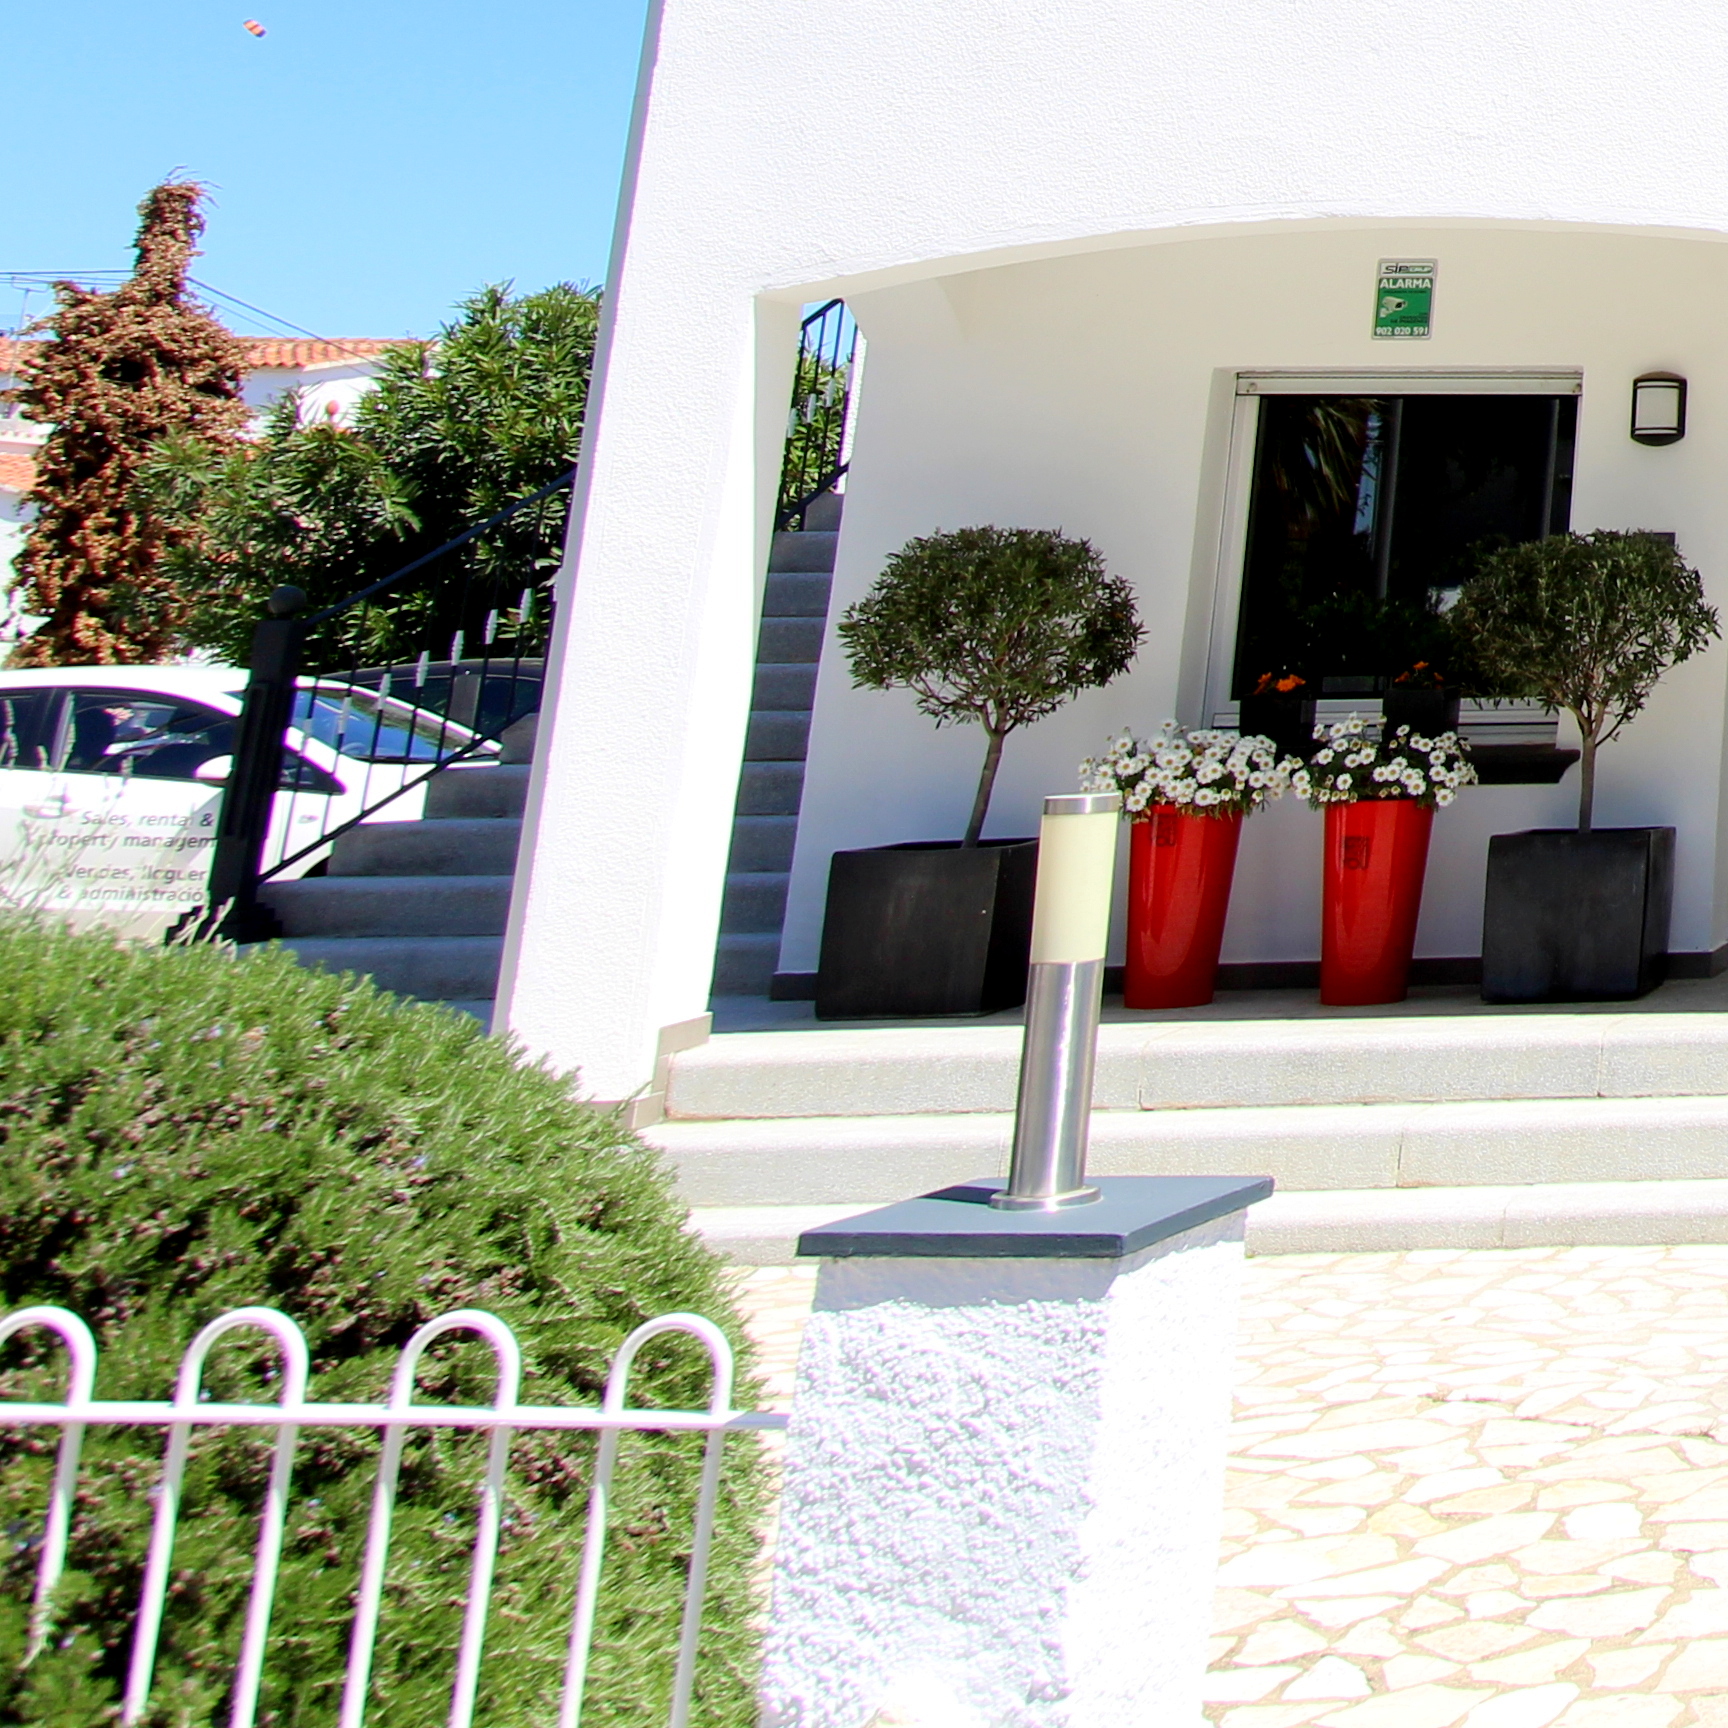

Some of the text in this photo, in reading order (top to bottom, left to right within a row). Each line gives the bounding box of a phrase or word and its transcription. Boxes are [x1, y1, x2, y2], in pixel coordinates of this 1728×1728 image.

[1380, 279, 1431, 288] ALARMA
[1376, 327, 1428, 335] 902 020 591
